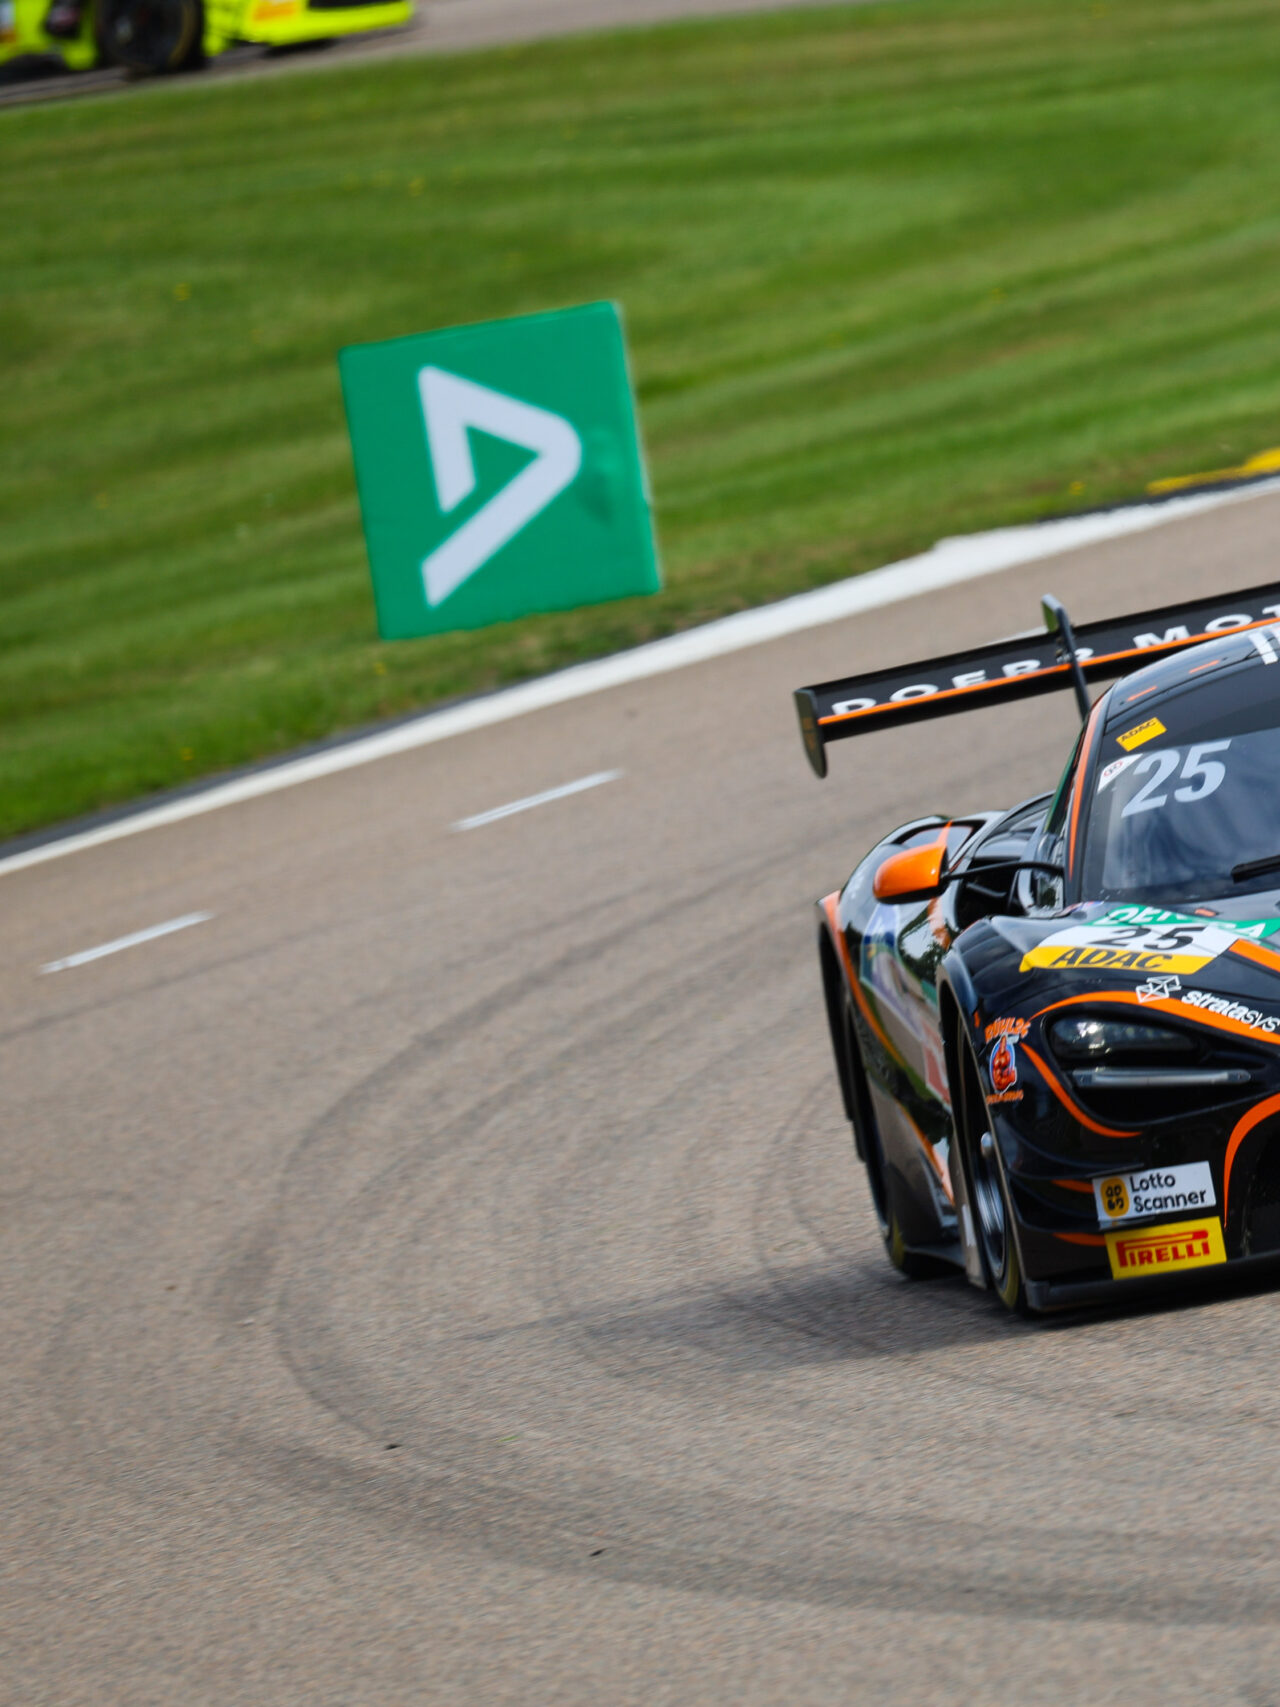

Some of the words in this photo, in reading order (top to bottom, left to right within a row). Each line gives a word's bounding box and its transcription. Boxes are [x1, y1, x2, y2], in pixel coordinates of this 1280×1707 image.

[1120, 740, 1232, 818] 25
[1088, 926, 1206, 950] 25
[1050, 946, 1173, 970] ADAC
[1181, 988, 1280, 1033] stratasys
[1129, 1172, 1176, 1193] Lotto
[1133, 1189, 1207, 1213] Scanner
[1115, 1229, 1210, 1268] PIRELLI
